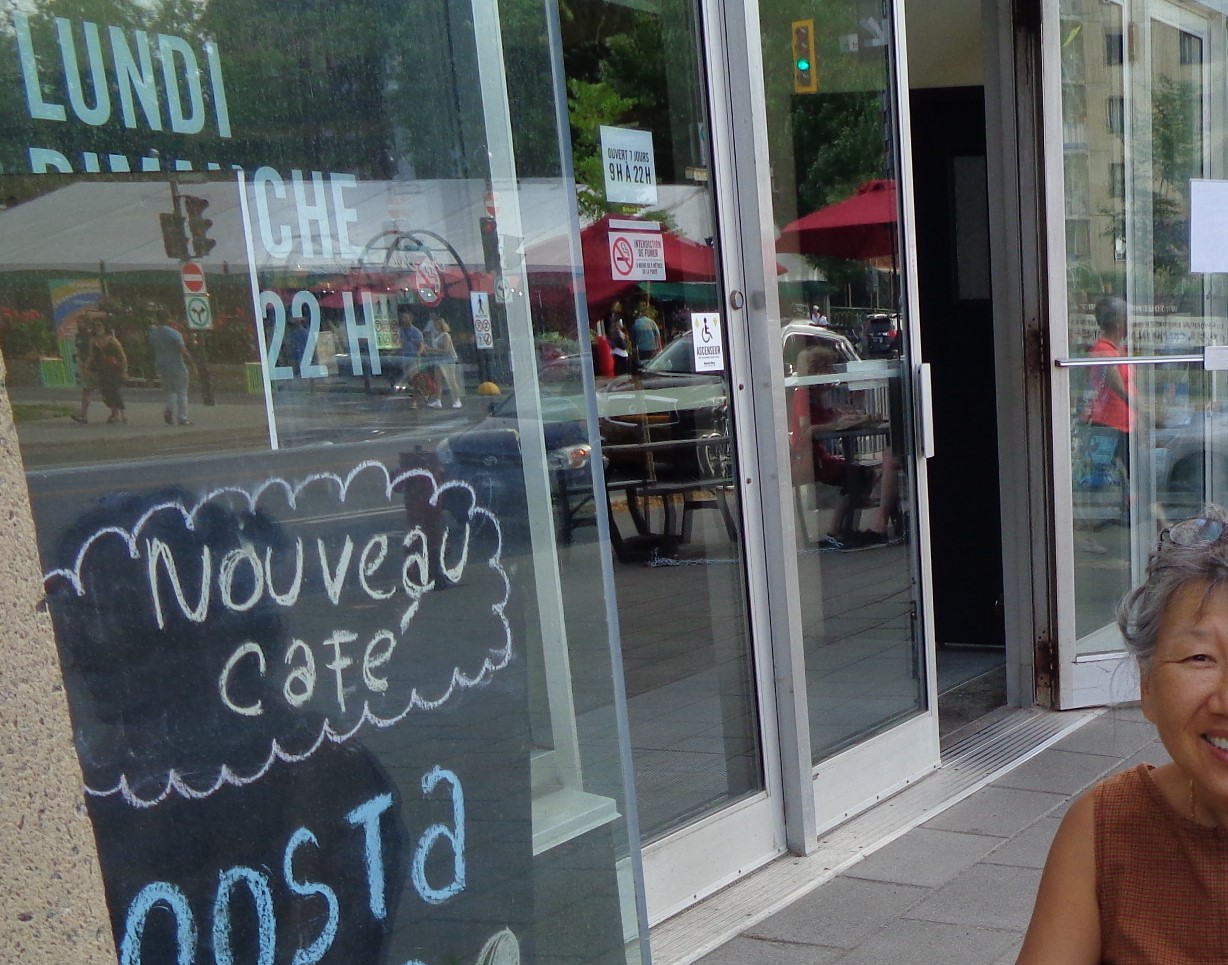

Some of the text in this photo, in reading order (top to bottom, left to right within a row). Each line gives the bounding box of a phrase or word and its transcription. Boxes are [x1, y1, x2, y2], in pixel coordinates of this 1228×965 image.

[13, 11, 233, 138] LUNDI
[607, 147, 650, 163] OUVERT 7 JOURS
[645, 249, 659, 258] FUMER
[259, 290, 383, 381] 22 H
[696, 345, 721, 356] ASCENSEUR
[146, 520, 470, 629] Nouveau
